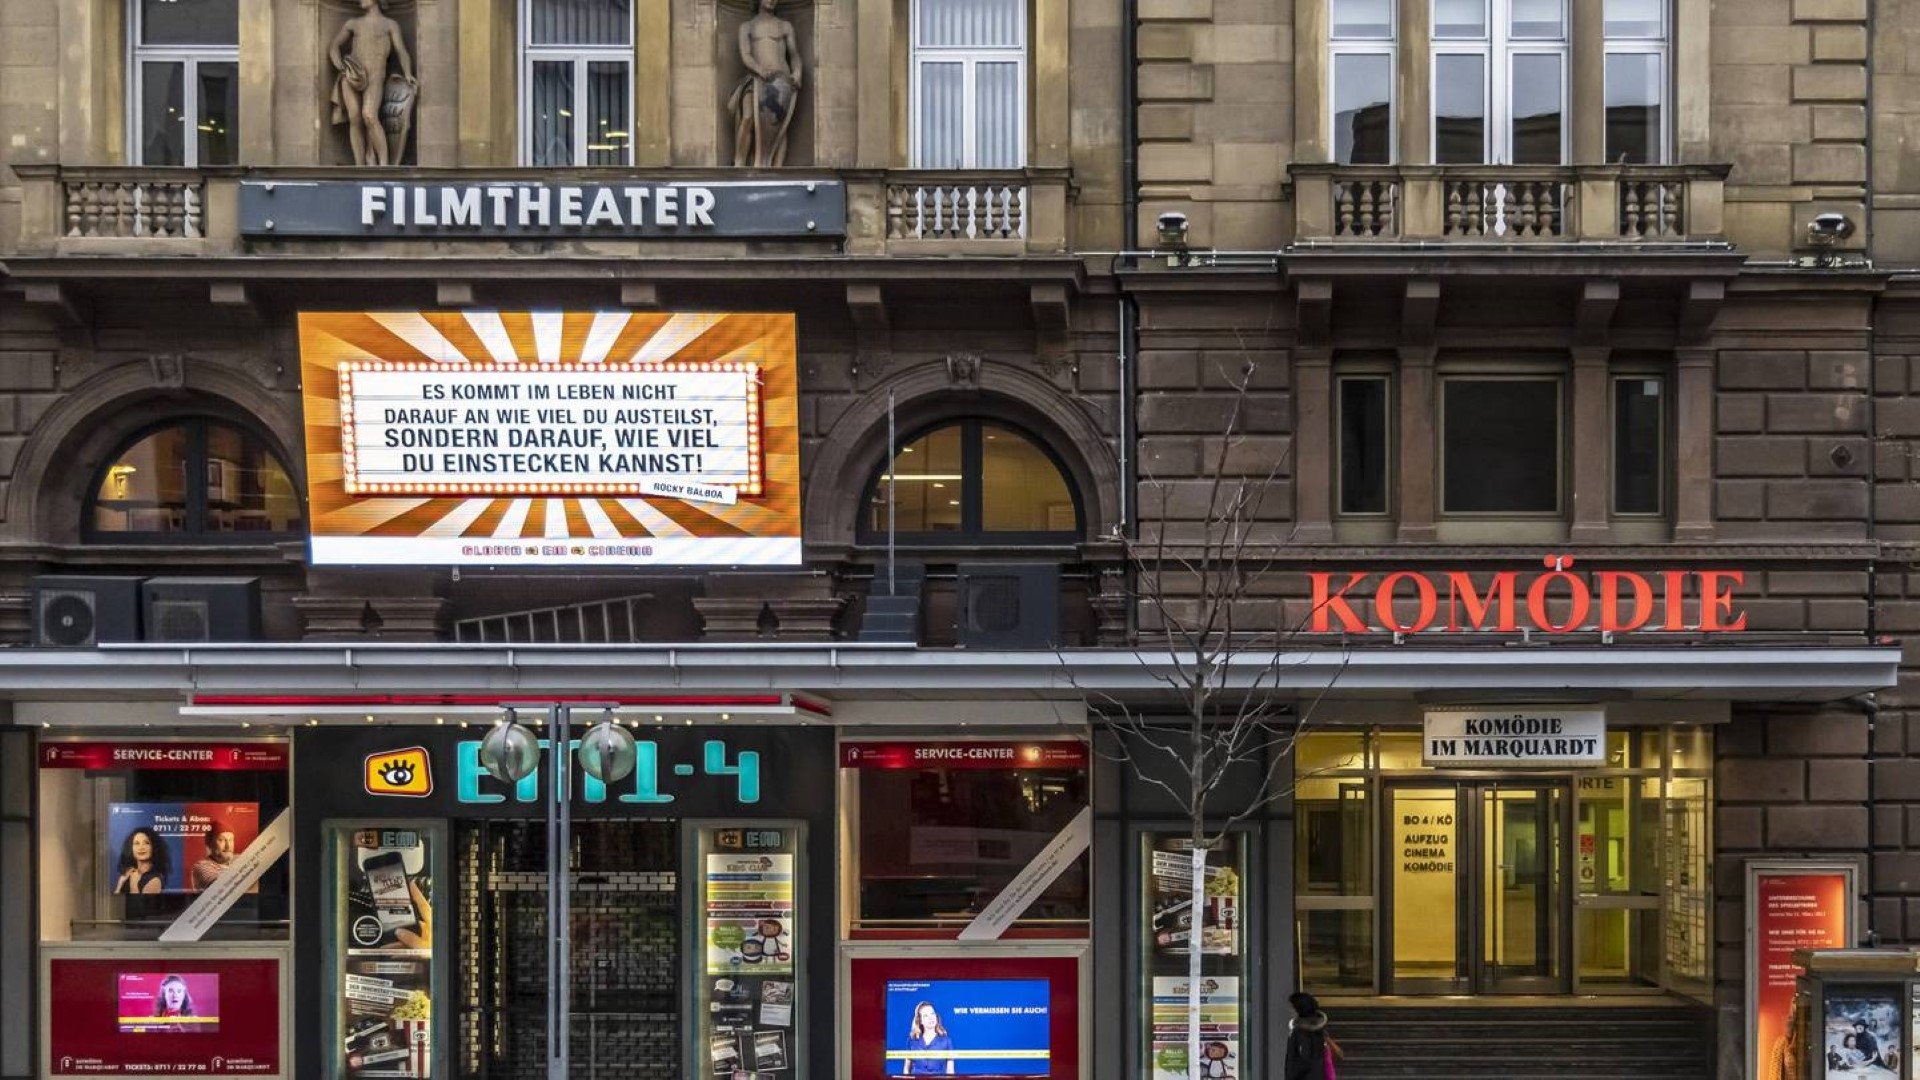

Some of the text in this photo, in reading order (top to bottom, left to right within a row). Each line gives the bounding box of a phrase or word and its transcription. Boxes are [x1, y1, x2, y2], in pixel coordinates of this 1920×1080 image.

[361, 187, 715, 228] FILMTHEATER
[422, 384, 677, 400] ES KOMMT IM LEBEN NICHT
[384, 409, 718, 427] DARAUF AN WIE VIEL DU AUSTEILST,
[384, 428, 719, 452] SONDERN DARAUF, WIE VIEL
[402, 453, 703, 473] DU EINSTECKEN KANNST!
[653, 483, 723, 499] ROCKY BALBOA
[1310, 554, 1747, 633] KOMÖDIE
[1465, 714, 1562, 735] KOMÖDIE
[113, 749, 214, 761] SERVICE-CENTER
[914, 748, 1014, 759] SERVICE-CENTER
[1431, 739, 1597, 758] IM MARQUARDT
[1578, 777, 1614, 789] RTE
[153, 824, 172, 832] 0711
[179, 824, 190, 832] 22
[190, 824, 201, 832] 77
[1404, 815, 1420, 825] BO
[1404, 834, 1449, 845] AUFZUG
[1404, 847, 1445, 858] CINEMA
[1403, 861, 1454, 872] KOMÖDIE
